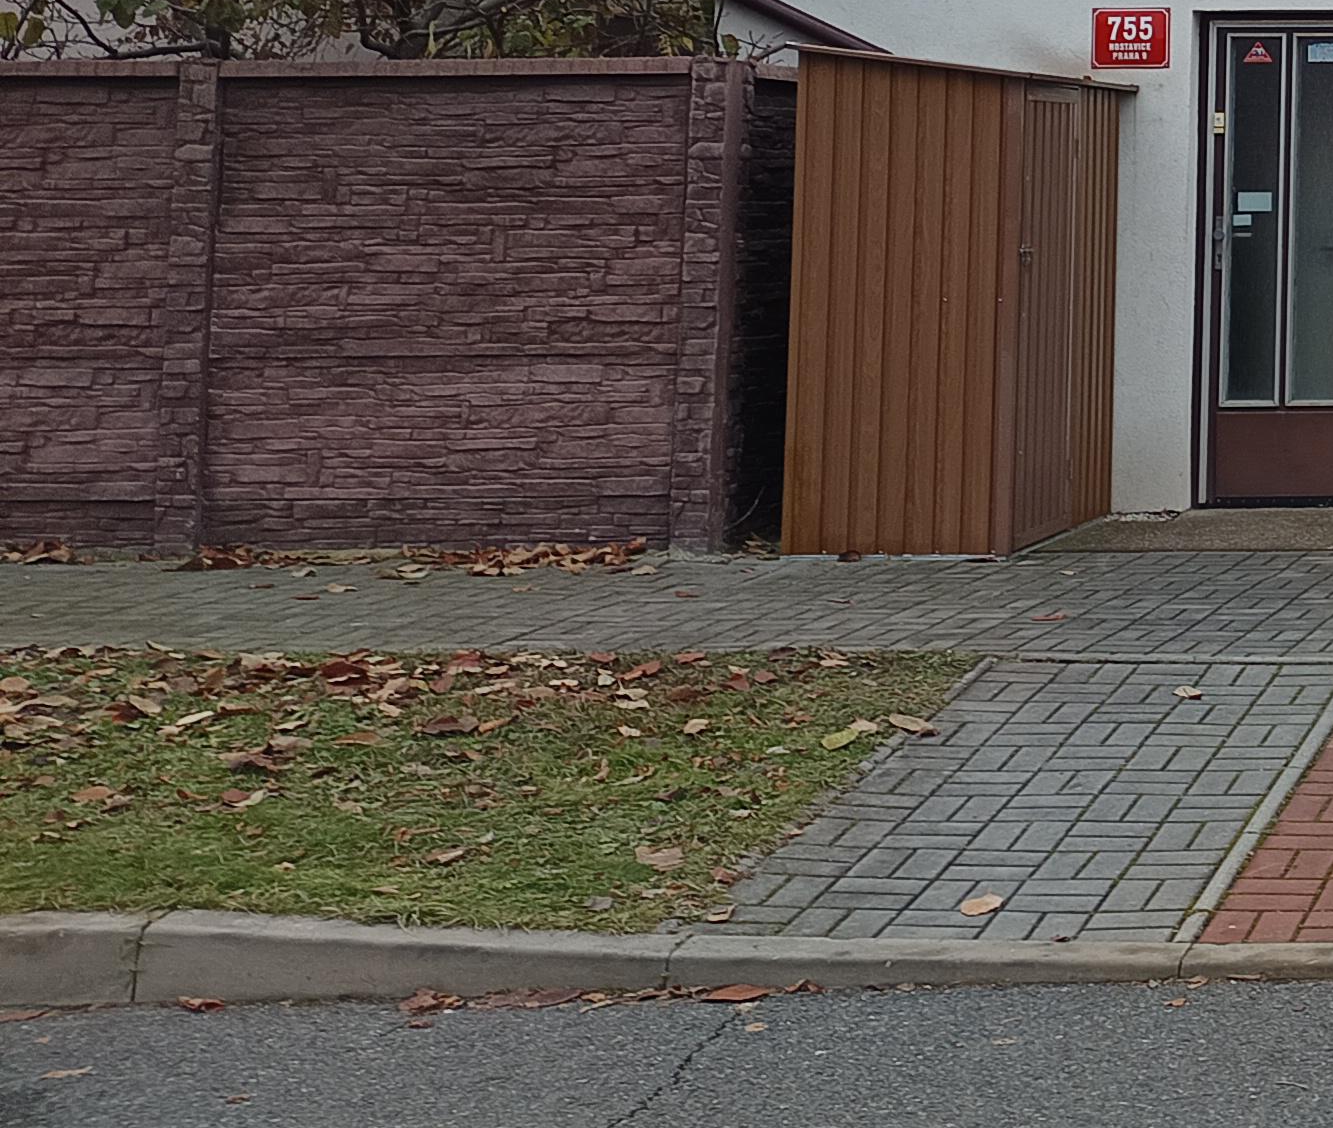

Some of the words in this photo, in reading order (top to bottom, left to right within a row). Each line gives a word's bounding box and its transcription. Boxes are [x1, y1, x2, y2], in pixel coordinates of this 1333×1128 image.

[1107, 16, 1153, 40] 755
[1108, 43, 1152, 51] HOSTAVICE
[1112, 52, 1140, 60] PRAHA
